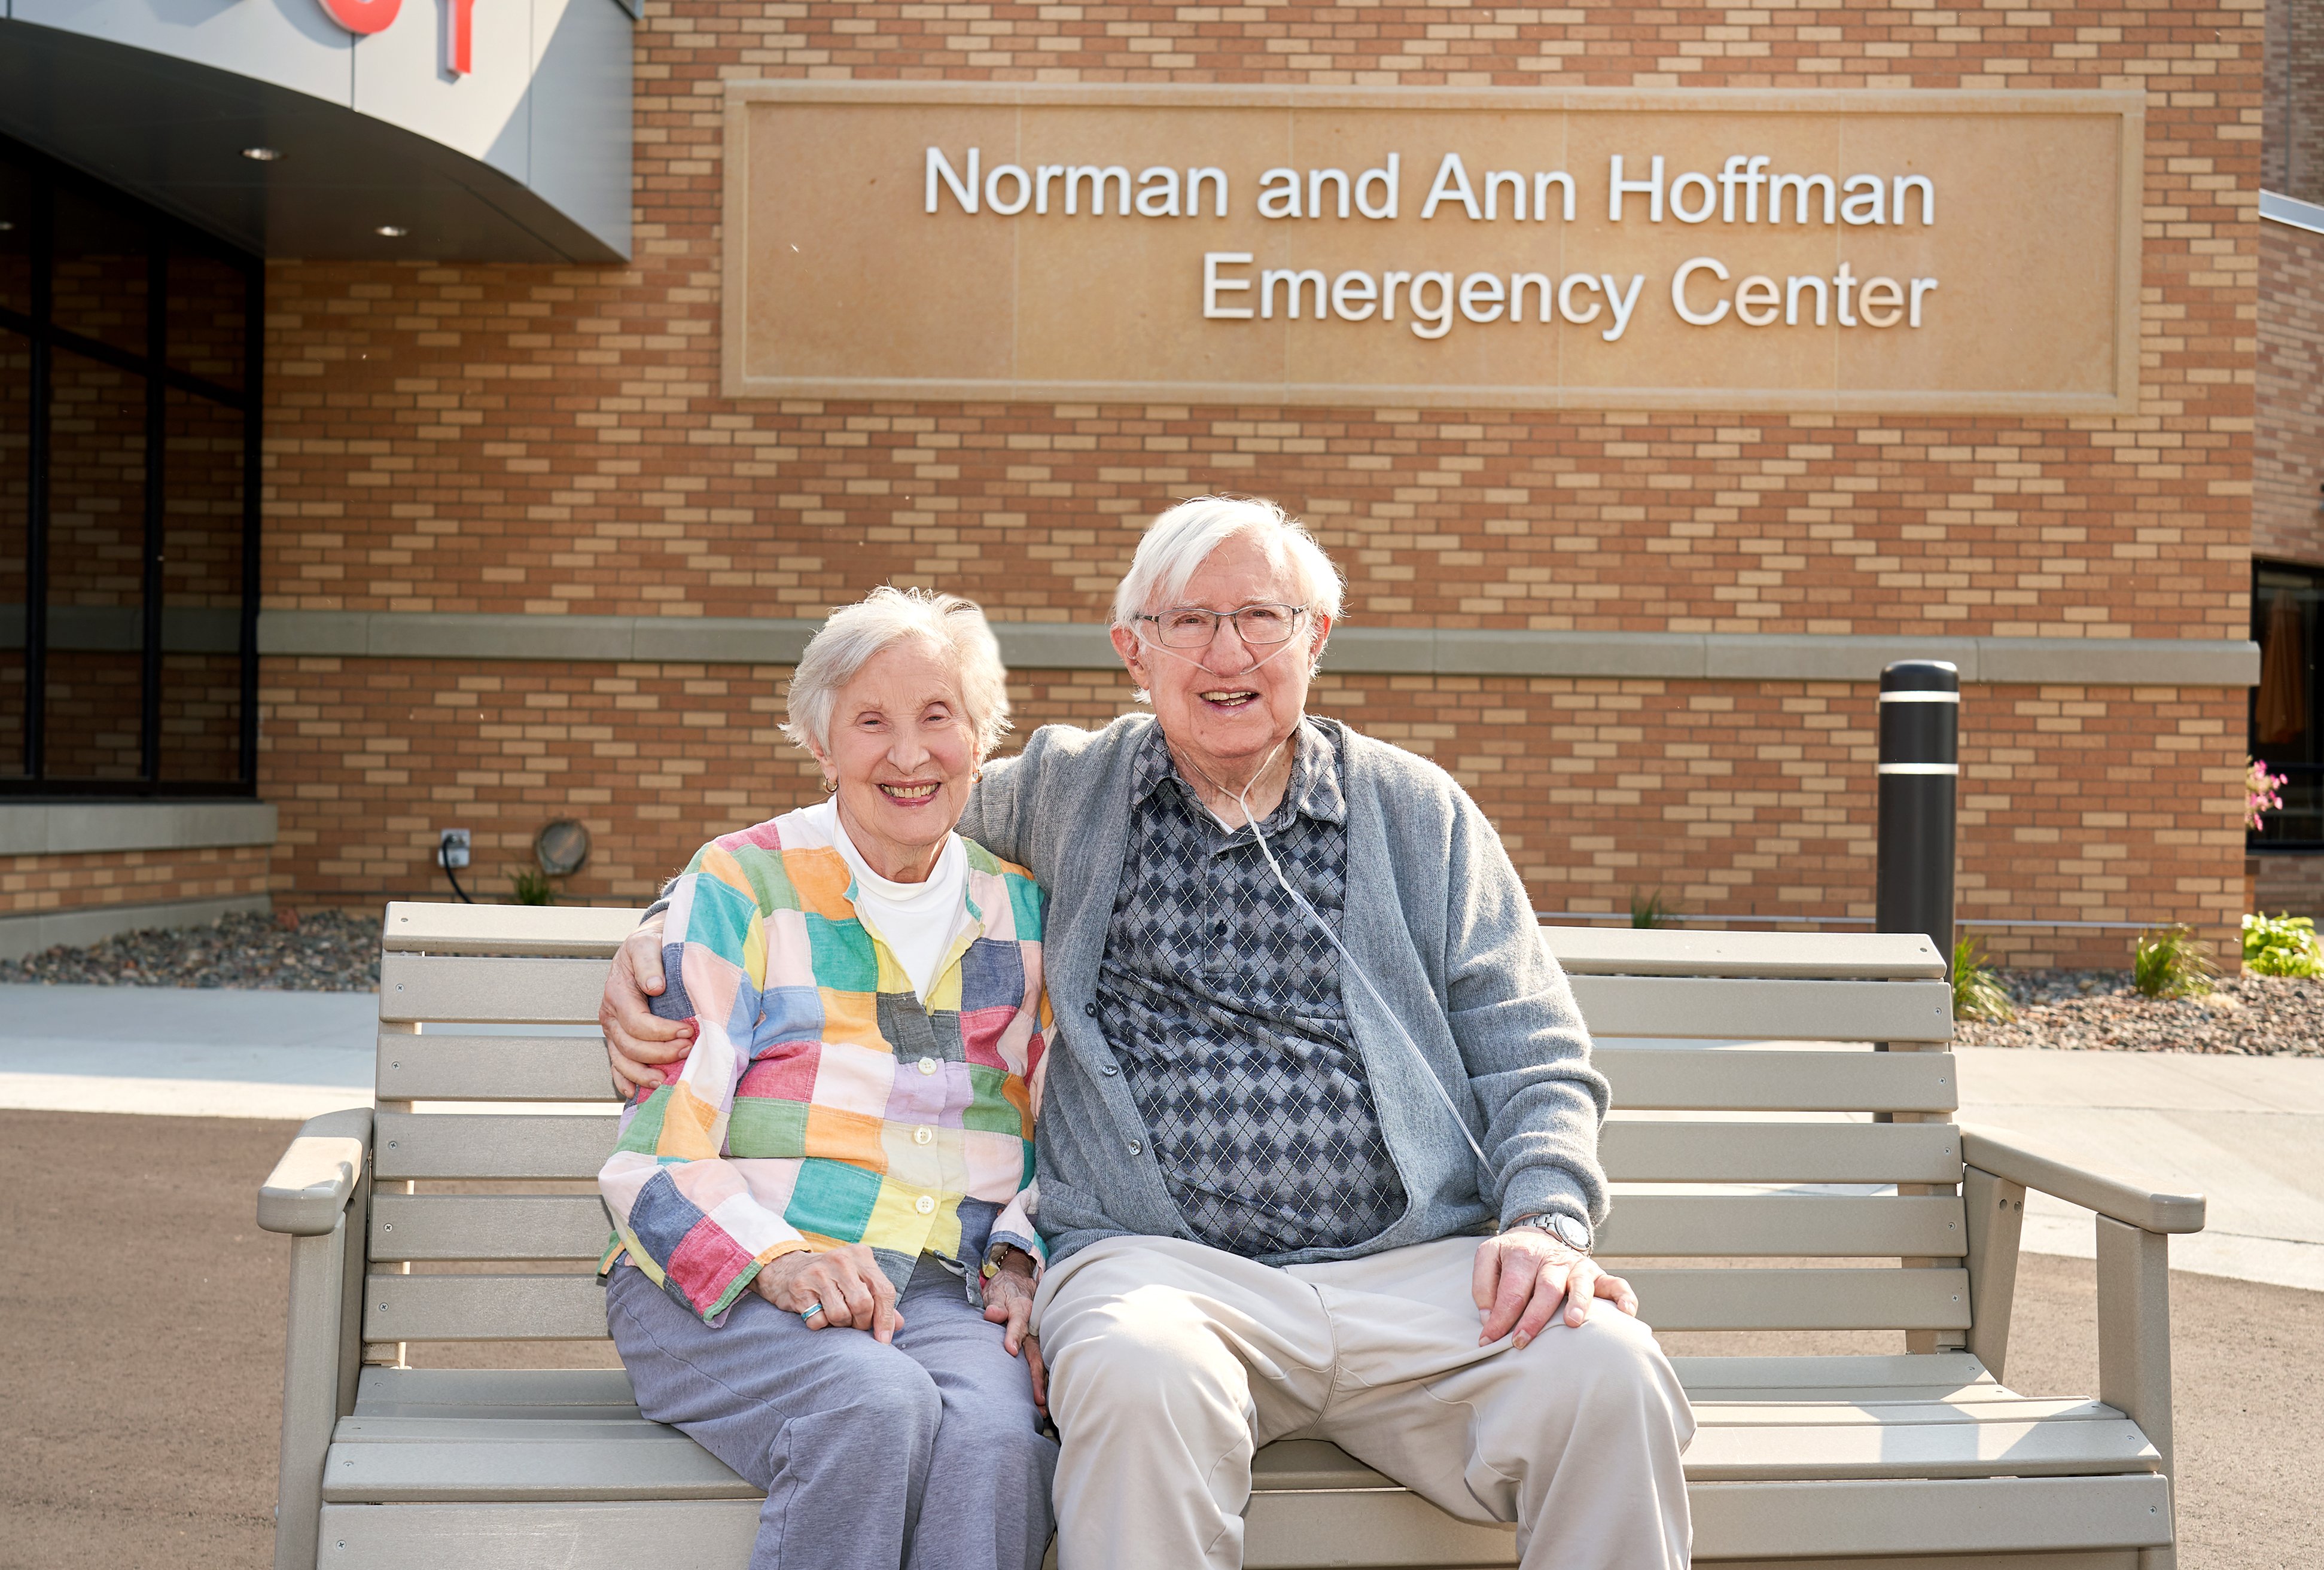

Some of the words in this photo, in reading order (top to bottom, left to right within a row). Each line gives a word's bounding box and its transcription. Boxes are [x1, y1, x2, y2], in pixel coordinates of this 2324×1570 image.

[925, 147, 1228, 217] Norman
[1257, 152, 1399, 220] and
[1420, 153, 1576, 221] Ann
[1609, 154, 1935, 225] Hoffman
[1202, 252, 1646, 342] Emergency
[1671, 257, 1939, 328] Center
